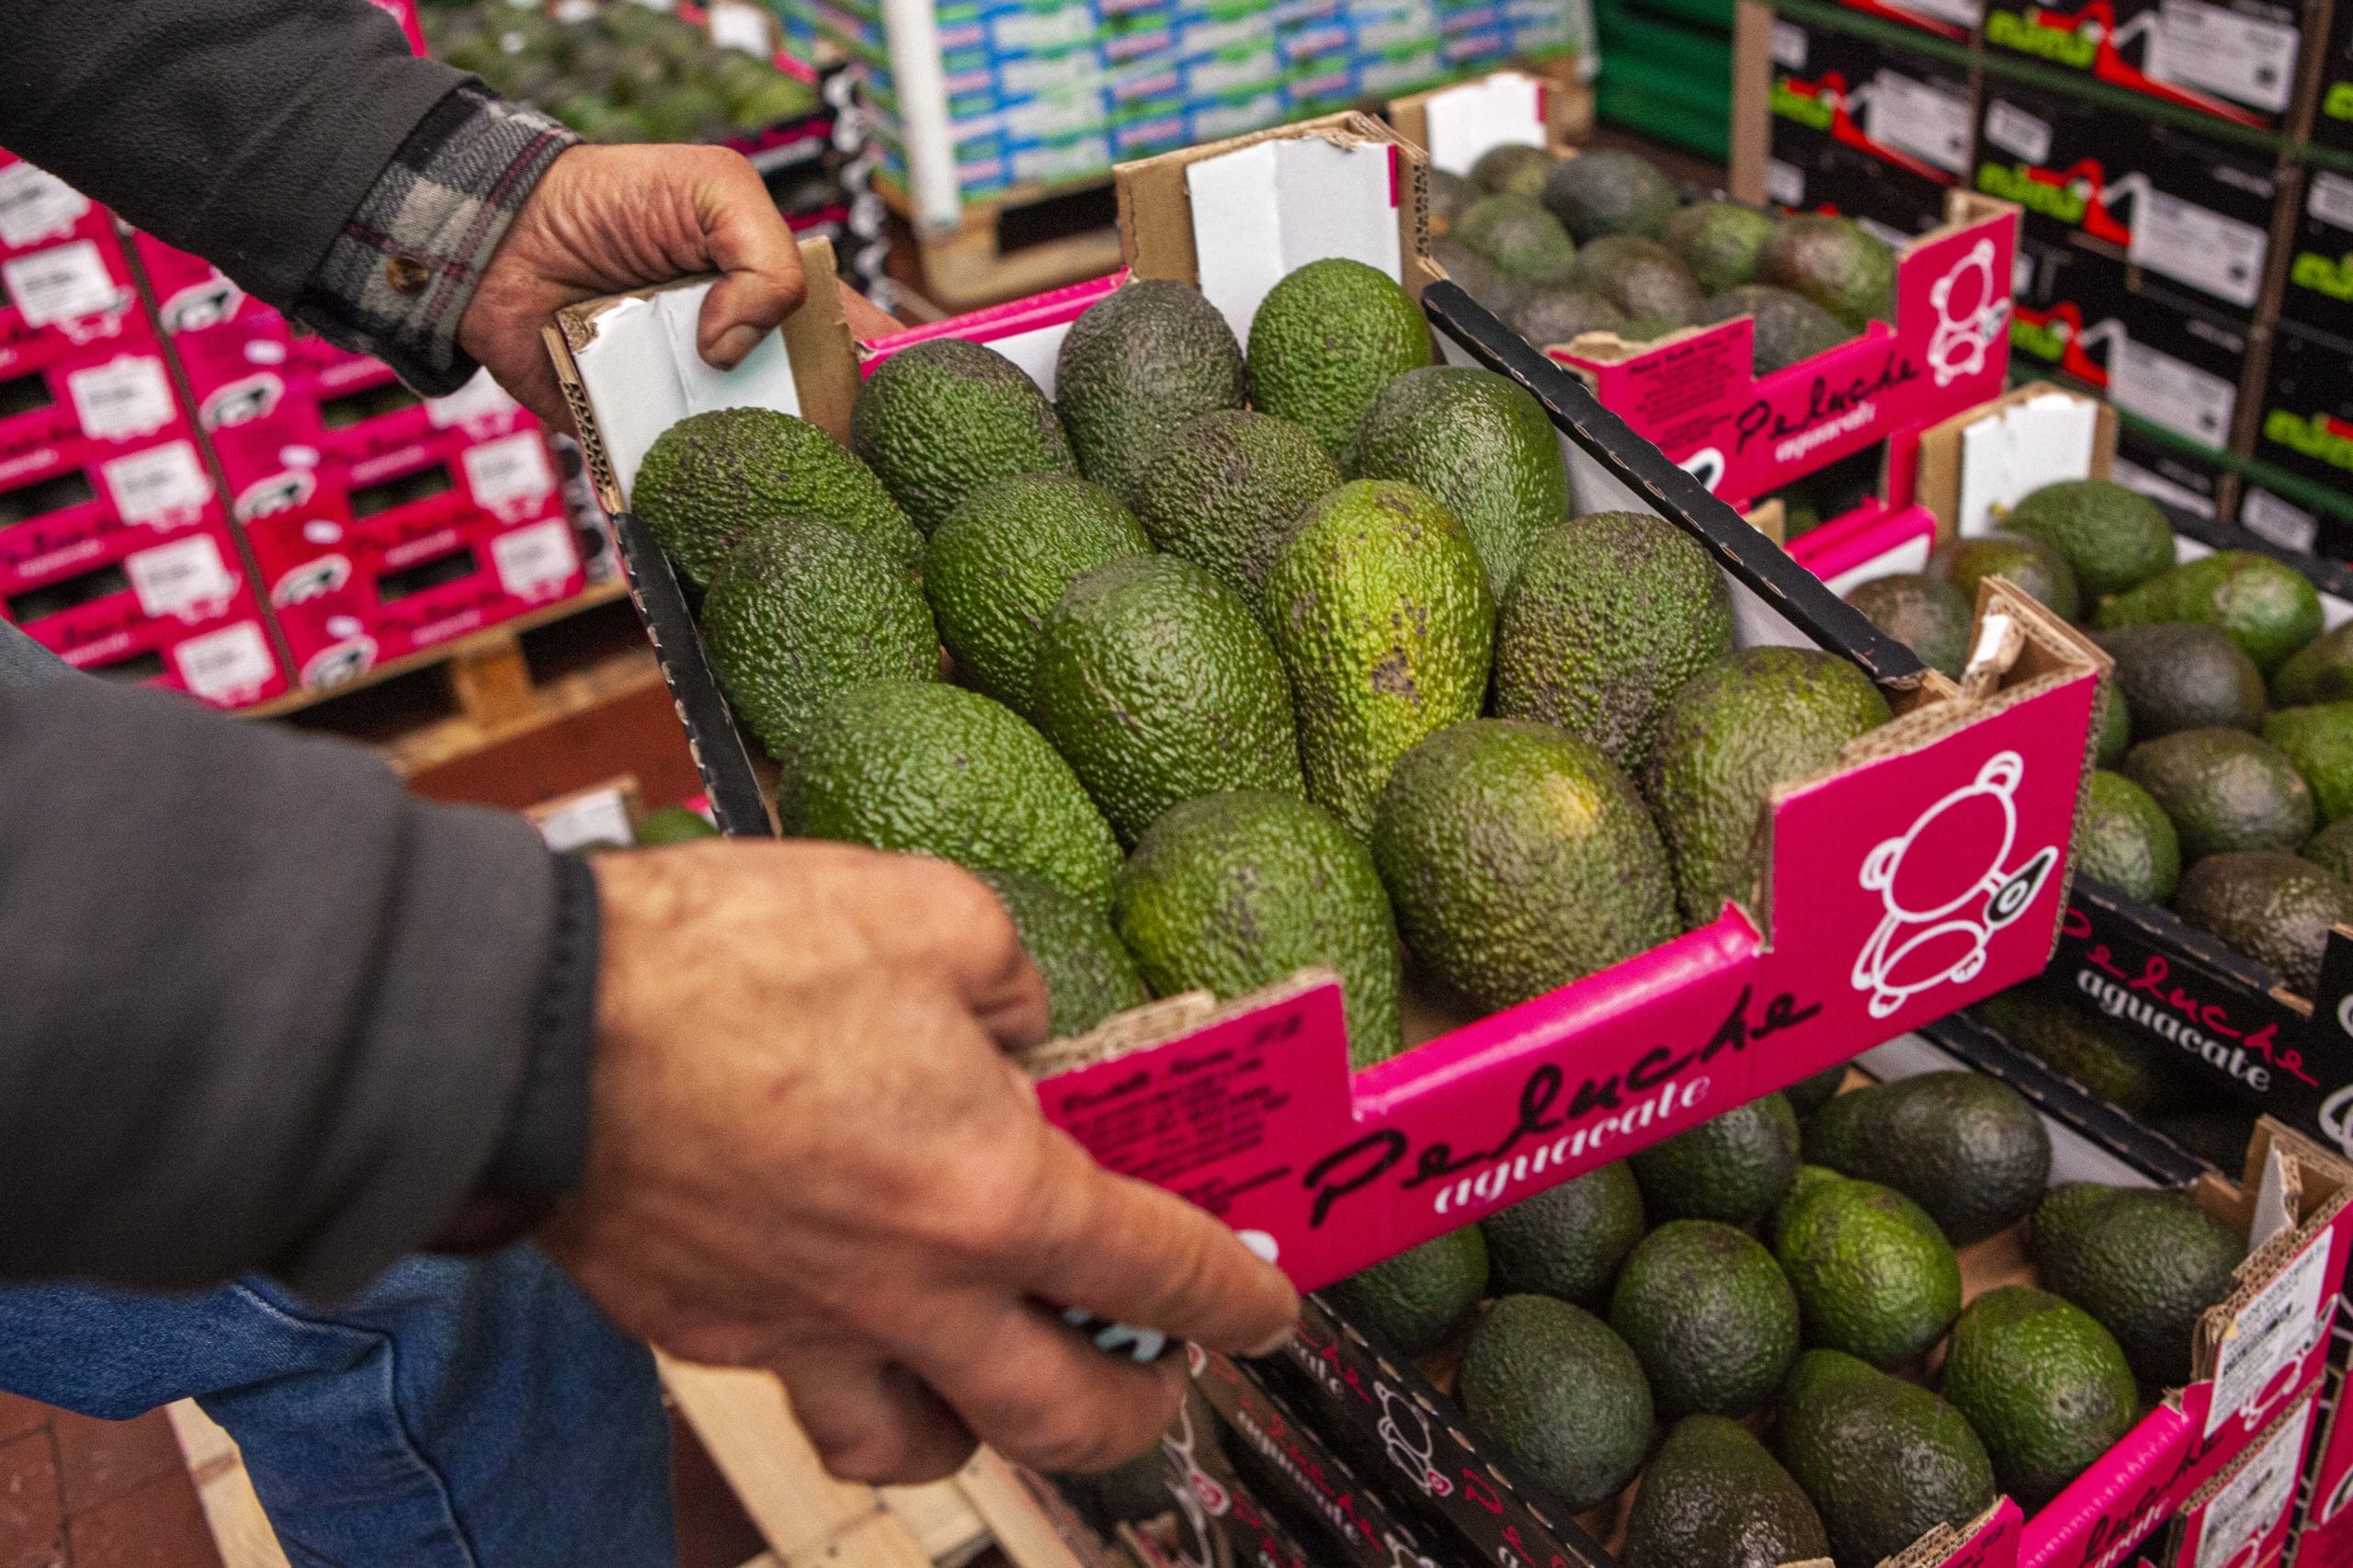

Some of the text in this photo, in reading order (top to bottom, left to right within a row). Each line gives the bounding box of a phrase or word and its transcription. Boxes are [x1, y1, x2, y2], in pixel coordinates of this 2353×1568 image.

[1735, 352, 1920, 455] Peluche
[2076, 970, 2272, 1093] aguacate
[1302, 983, 1823, 1229] Peluche
[1434, 1075, 1711, 1215] aguacate
